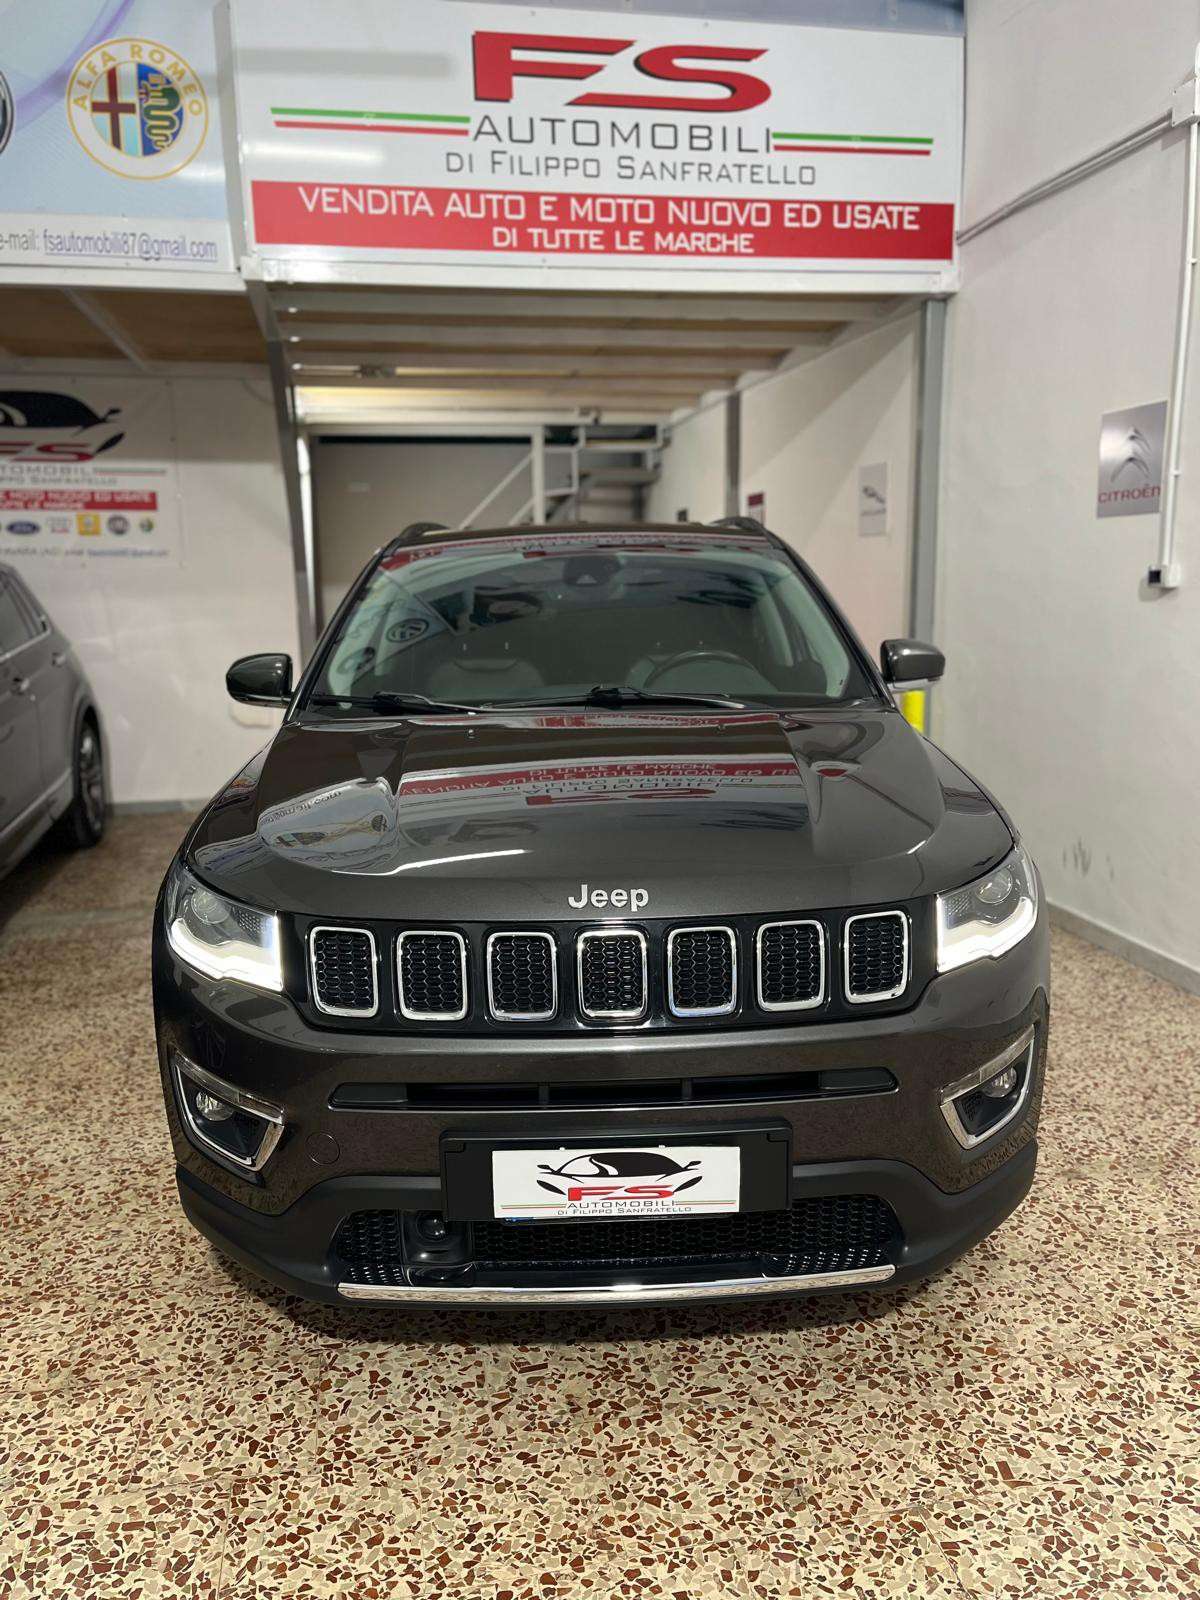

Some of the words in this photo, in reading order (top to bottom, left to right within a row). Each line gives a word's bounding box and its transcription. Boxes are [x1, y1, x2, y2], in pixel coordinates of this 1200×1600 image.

[73, 50, 117, 111] ALFA
[130, 44, 203, 117] ROMEO
[472, 30, 772, 113] FS
[472, 114, 771, 154] AUTOMOBILI
[446, 152, 473, 173] DI
[491, 151, 600, 179] FILIPPO
[617, 156, 816, 186] SANFRATELLO
[298, 185, 435, 217] VENDITA
[444, 193, 526, 220] AUTO
[539, 196, 558, 221] E
[570, 197, 655, 224] MOTO
[668, 202, 771, 227] NUOVO
[783, 203, 821, 228] ED
[832, 204, 920, 231] USATE
[492, 226, 517, 247] DI
[527, 227, 605, 250] TUTTE
[614, 230, 644, 251] LE
[655, 231, 755, 254] MARCHE
[567, 884, 649, 912] Jeep
[567, 1184, 675, 1201] FS
[567, 1200, 676, 1209] AUTOMOBILI
[572, 1207, 613, 1215] FILIPPO
[617, 1206, 692, 1215] SANFRATELLO
